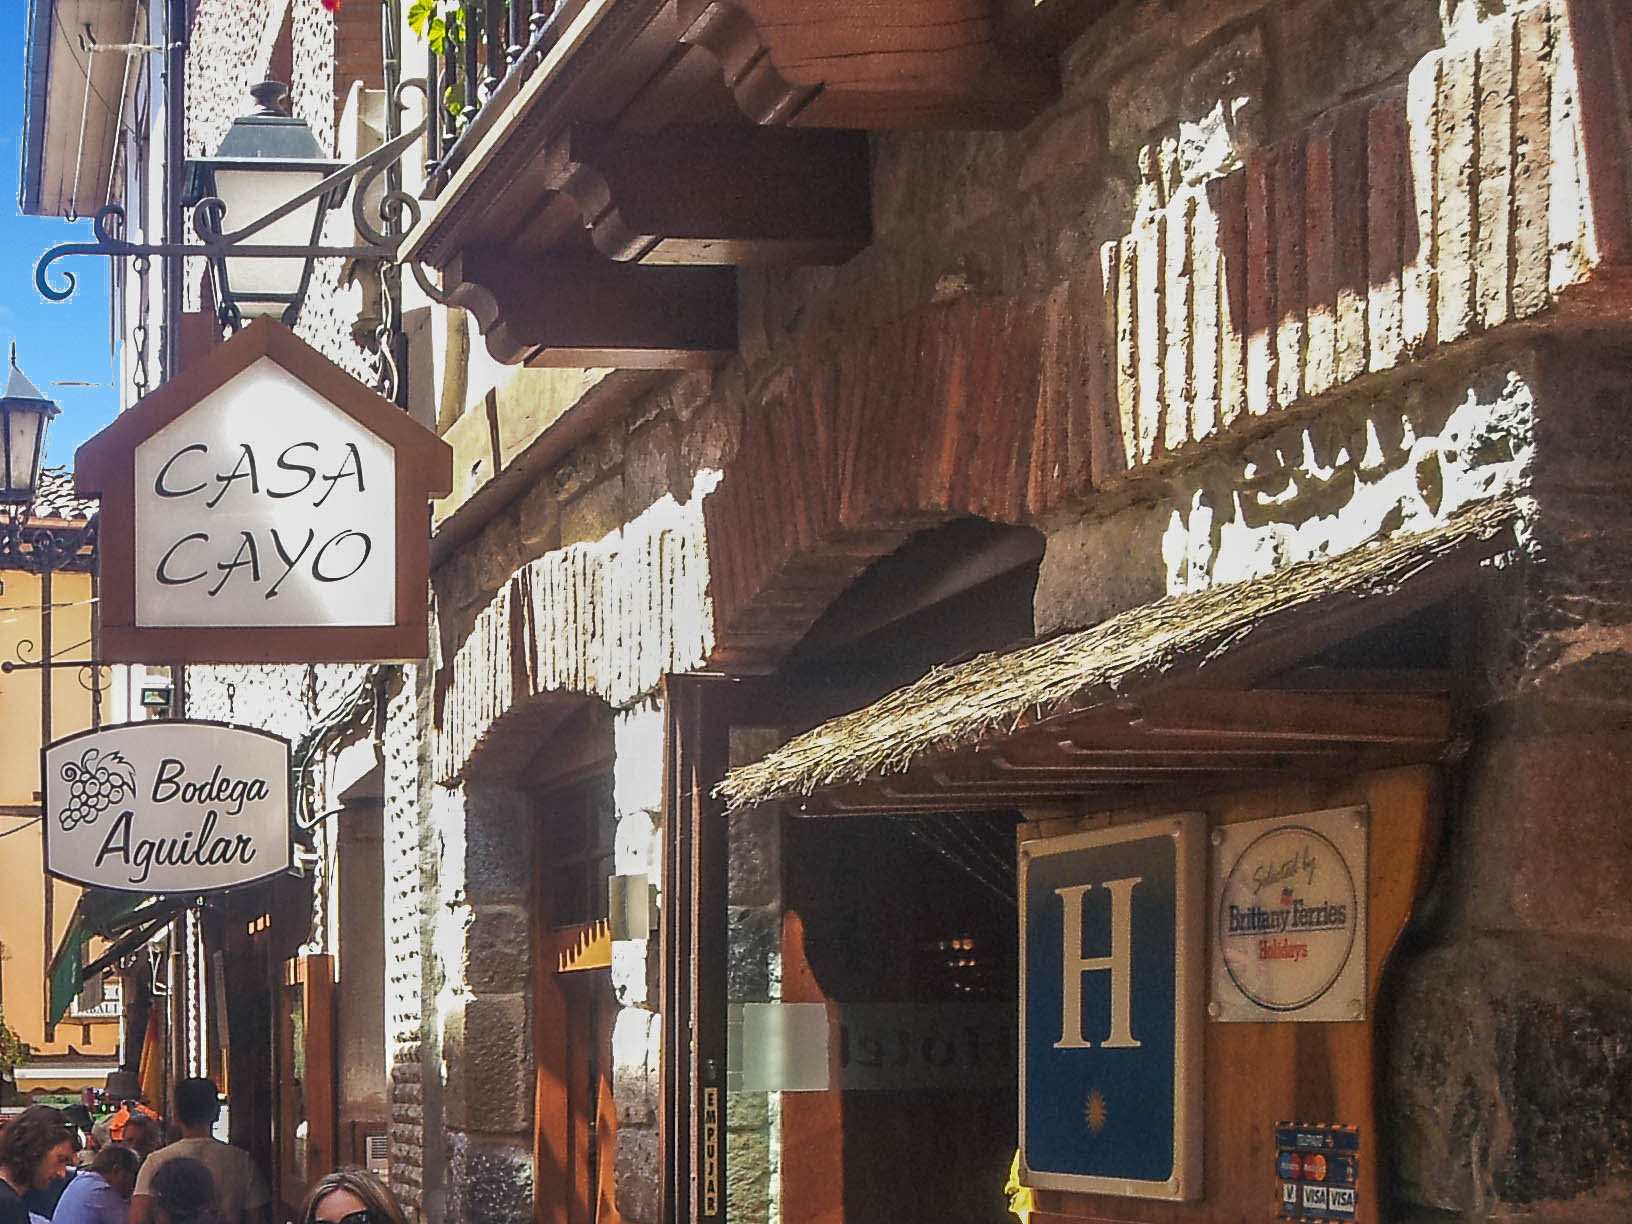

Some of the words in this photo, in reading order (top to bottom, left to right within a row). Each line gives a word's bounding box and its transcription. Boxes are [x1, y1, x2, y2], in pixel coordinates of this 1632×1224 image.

[154, 441, 366, 508] CASA
[156, 527, 373, 600] CAYO
[150, 757, 268, 816] Bodega
[95, 809, 256, 883] Aguilar
[1229, 904, 1290, 933] Brittany
[1292, 899, 1346, 928] Ferries
[1053, 876, 1142, 1049] H
[704, 1091, 717, 1211] EMPUJAR
[1304, 1189, 1326, 1205] VISA
[1330, 1191, 1353, 1207] VISA
